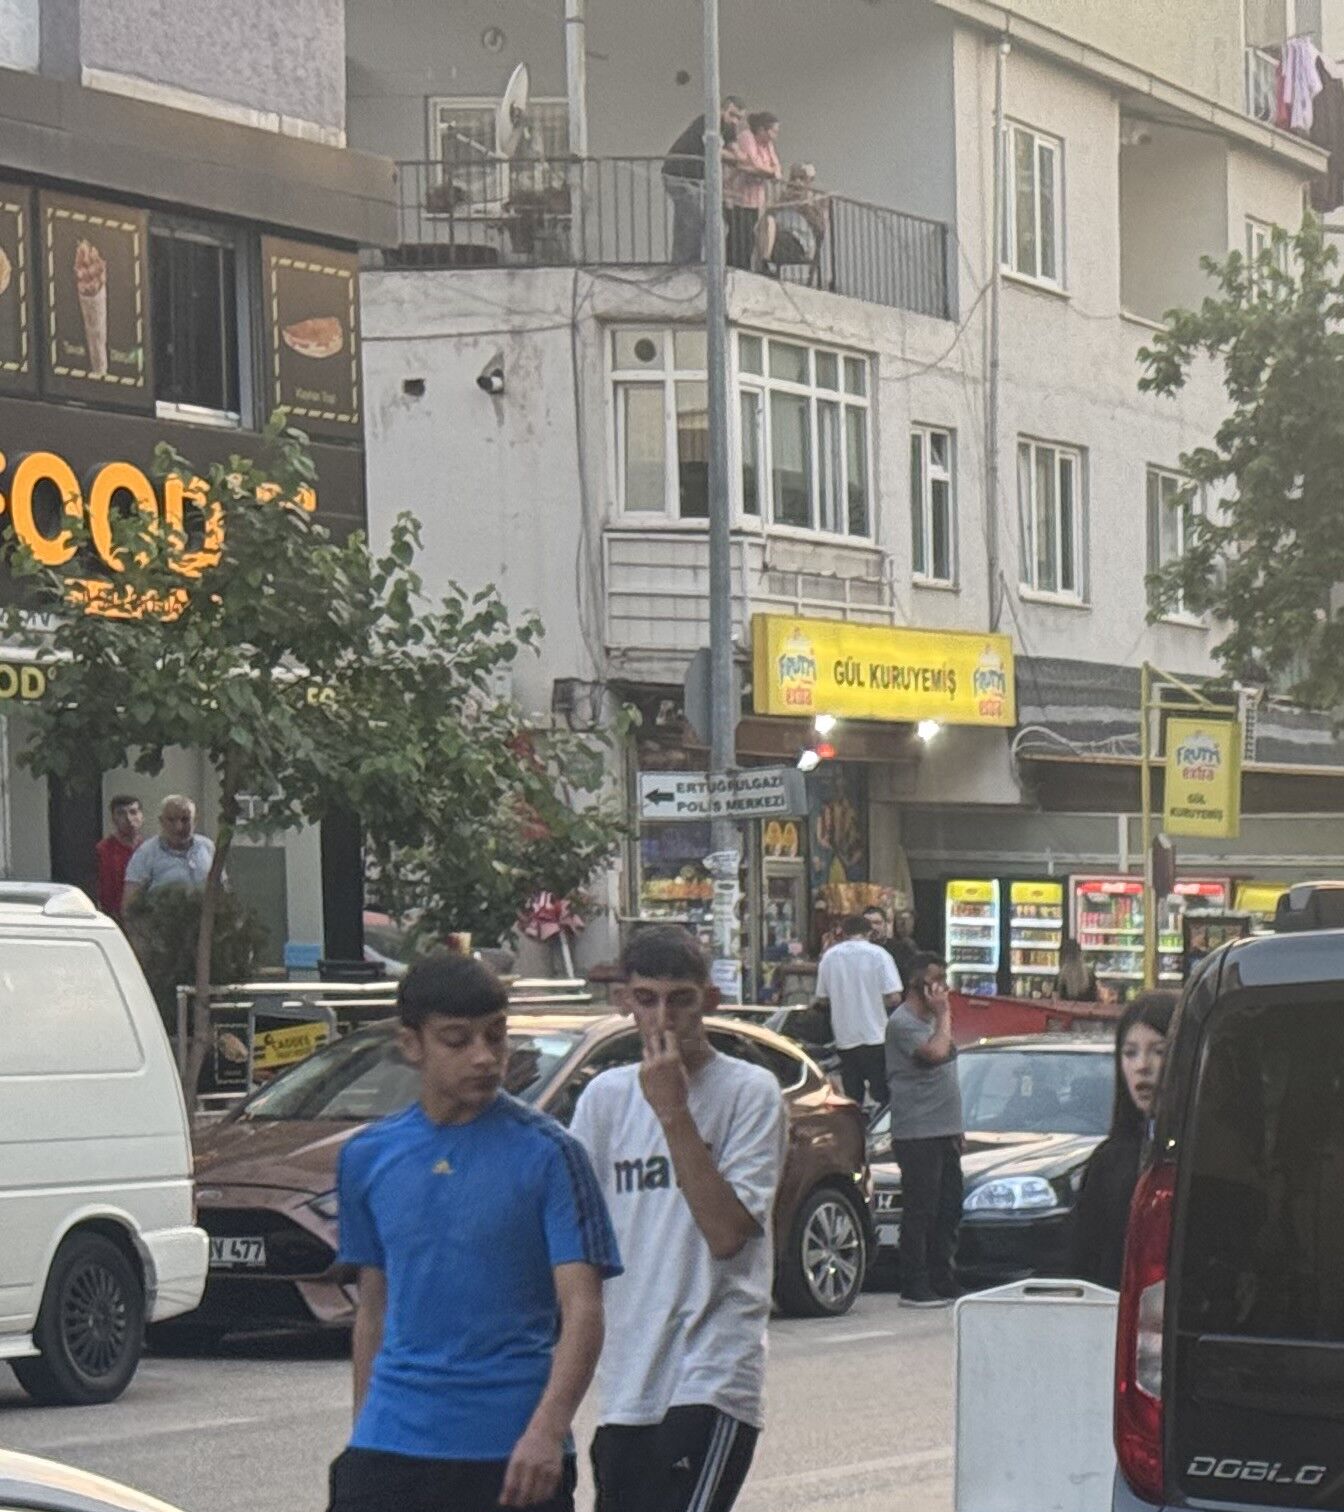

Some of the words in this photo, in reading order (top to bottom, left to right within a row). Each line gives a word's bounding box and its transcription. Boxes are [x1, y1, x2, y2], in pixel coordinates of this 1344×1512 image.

[0, 450, 225, 578] OOD
[833, 656, 865, 688] GÜL
[869, 662, 957, 700] KURUYEMİŞ
[231, 1240, 263, 1260] 477
[1186, 1456, 1328, 1485] DOBLO
